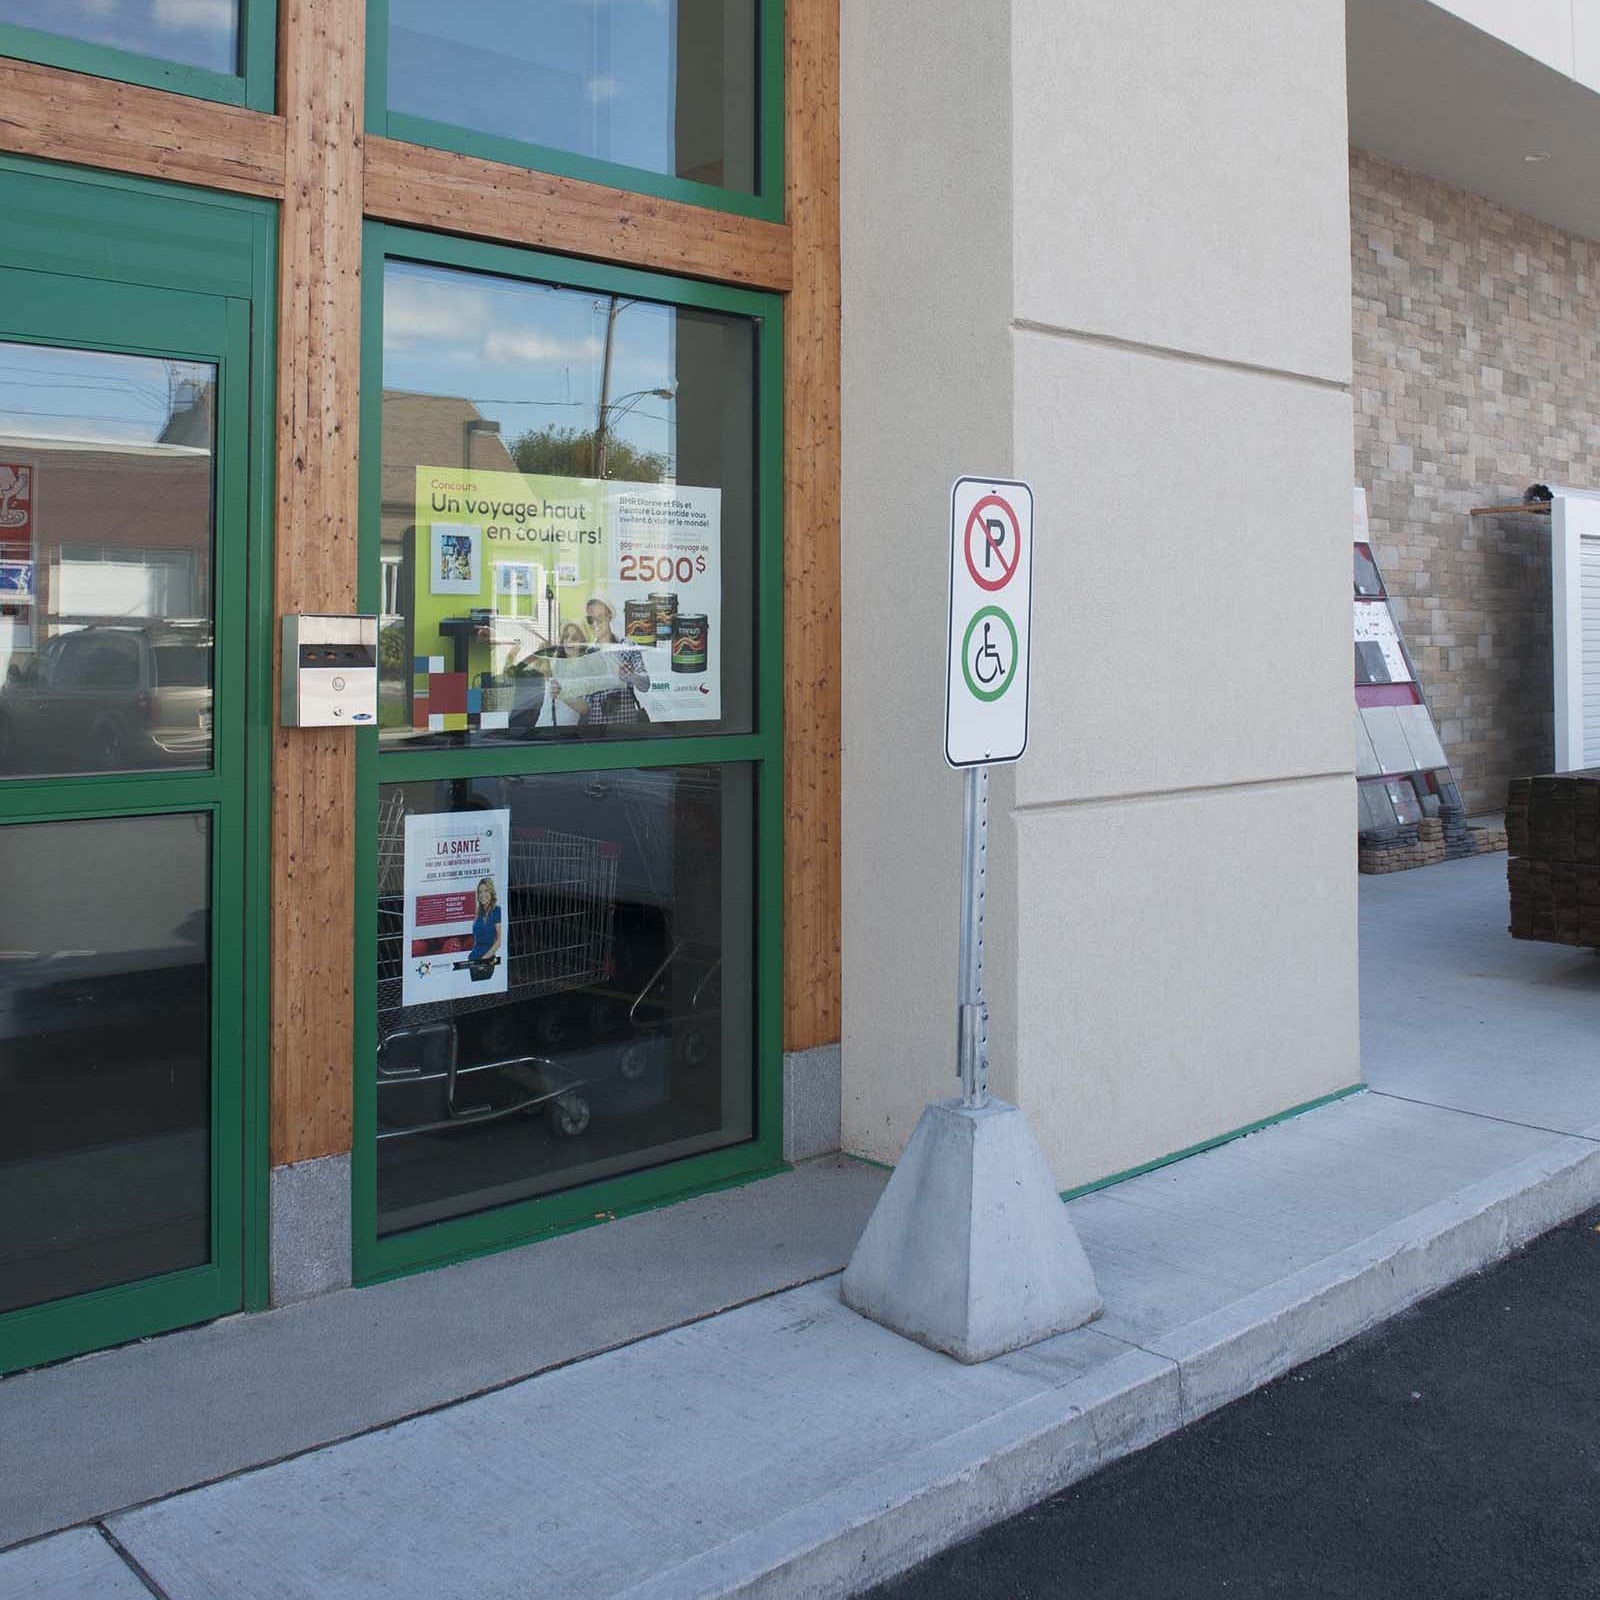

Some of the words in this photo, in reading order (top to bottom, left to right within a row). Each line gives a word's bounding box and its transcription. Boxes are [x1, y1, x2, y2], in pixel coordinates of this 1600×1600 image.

[431, 479, 478, 491] Concours
[431, 493, 460, 513] Un
[465, 499, 538, 524] voyage
[543, 500, 586, 520] haut
[672, 501, 683, 509] Fils
[487, 526, 511, 540] en
[516, 526, 602, 544] couleurs!
[437, 842, 448, 855] LA
[451, 837, 481, 854] SANTÉ
